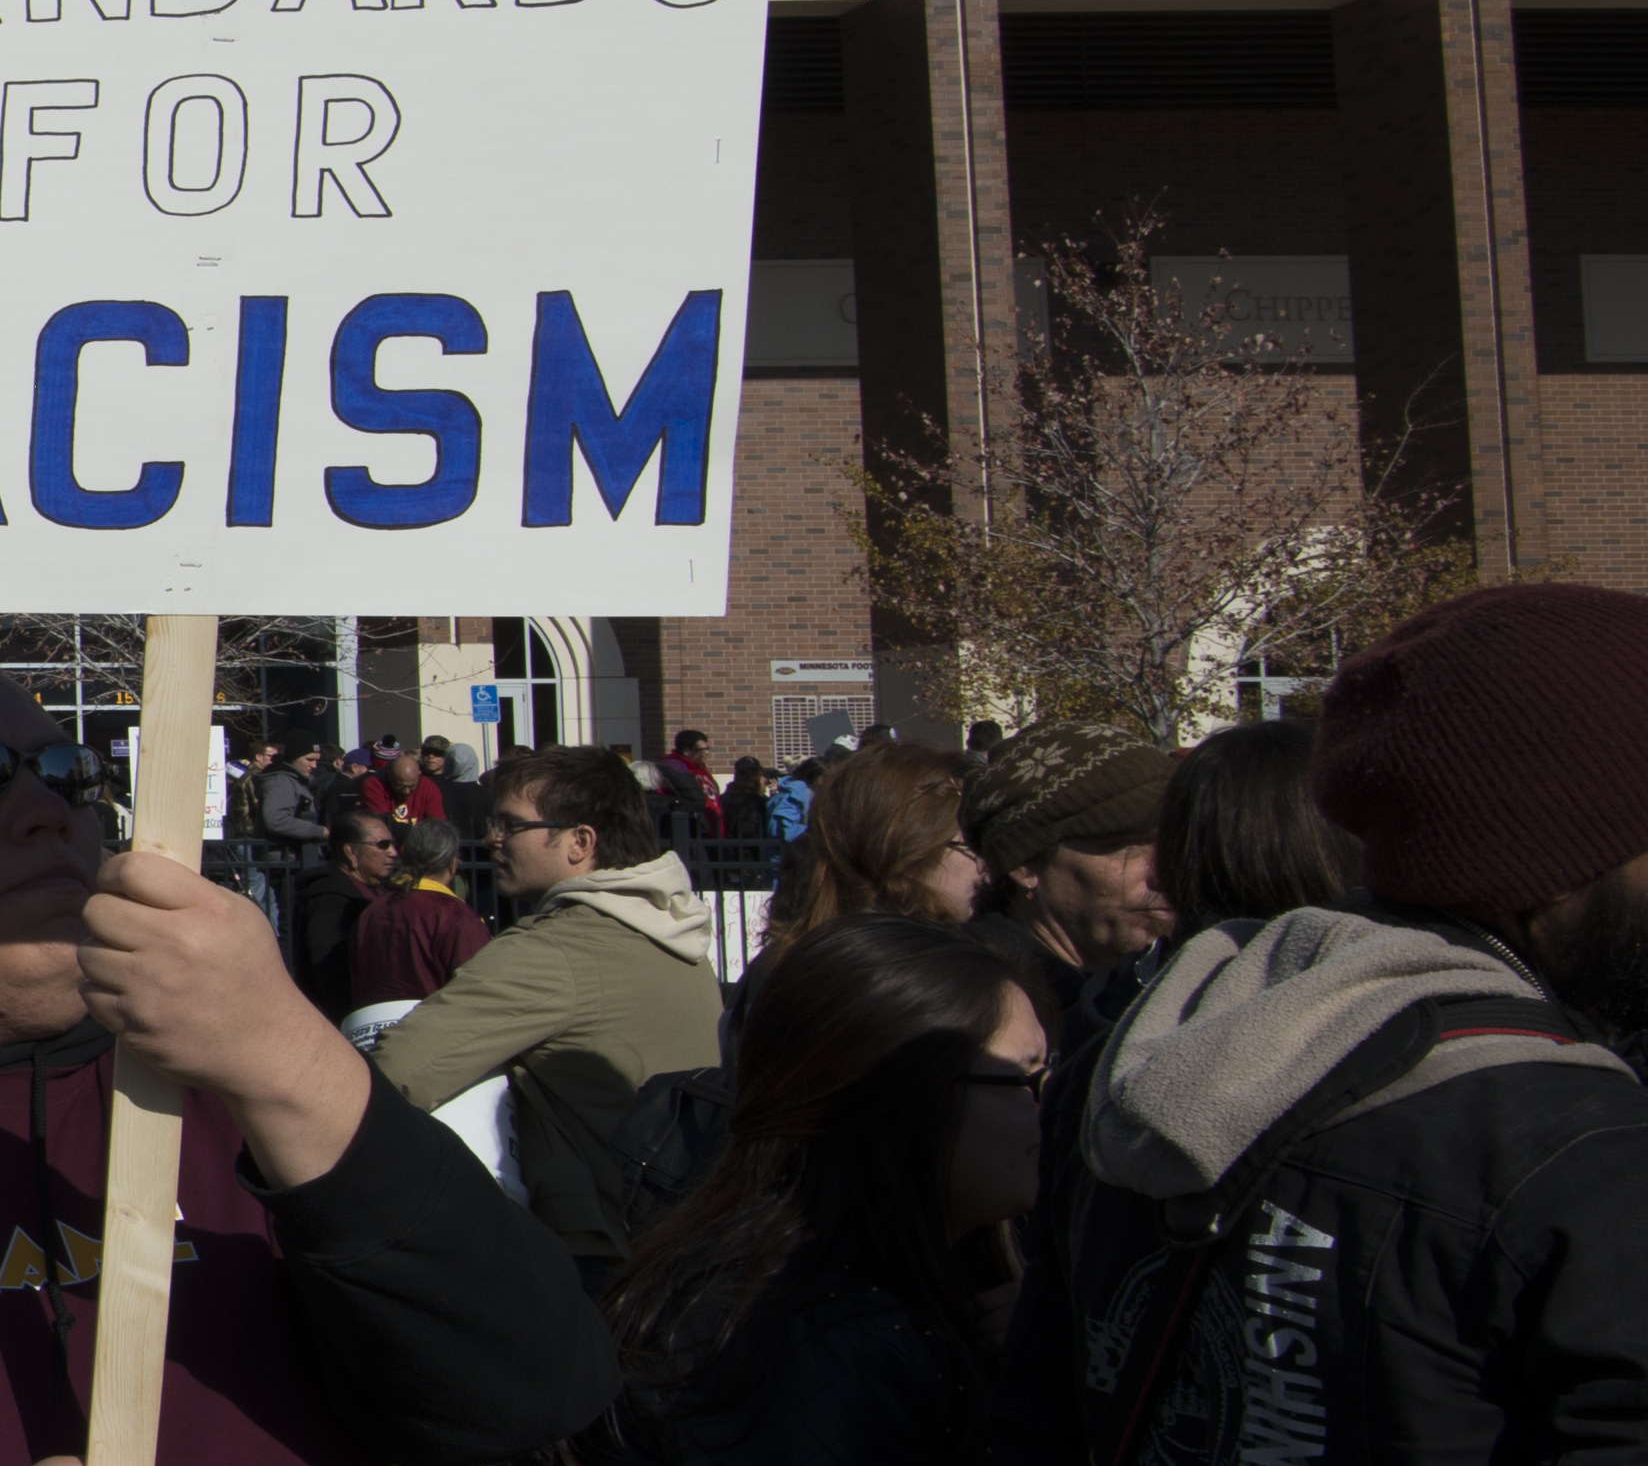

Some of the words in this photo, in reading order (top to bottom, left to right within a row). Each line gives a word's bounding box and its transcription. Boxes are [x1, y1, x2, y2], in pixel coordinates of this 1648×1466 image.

[1224, 289, 1353, 329] CHIPPE
[799, 662, 850, 671] MINNESOTA
[116, 692, 134, 704] 15
